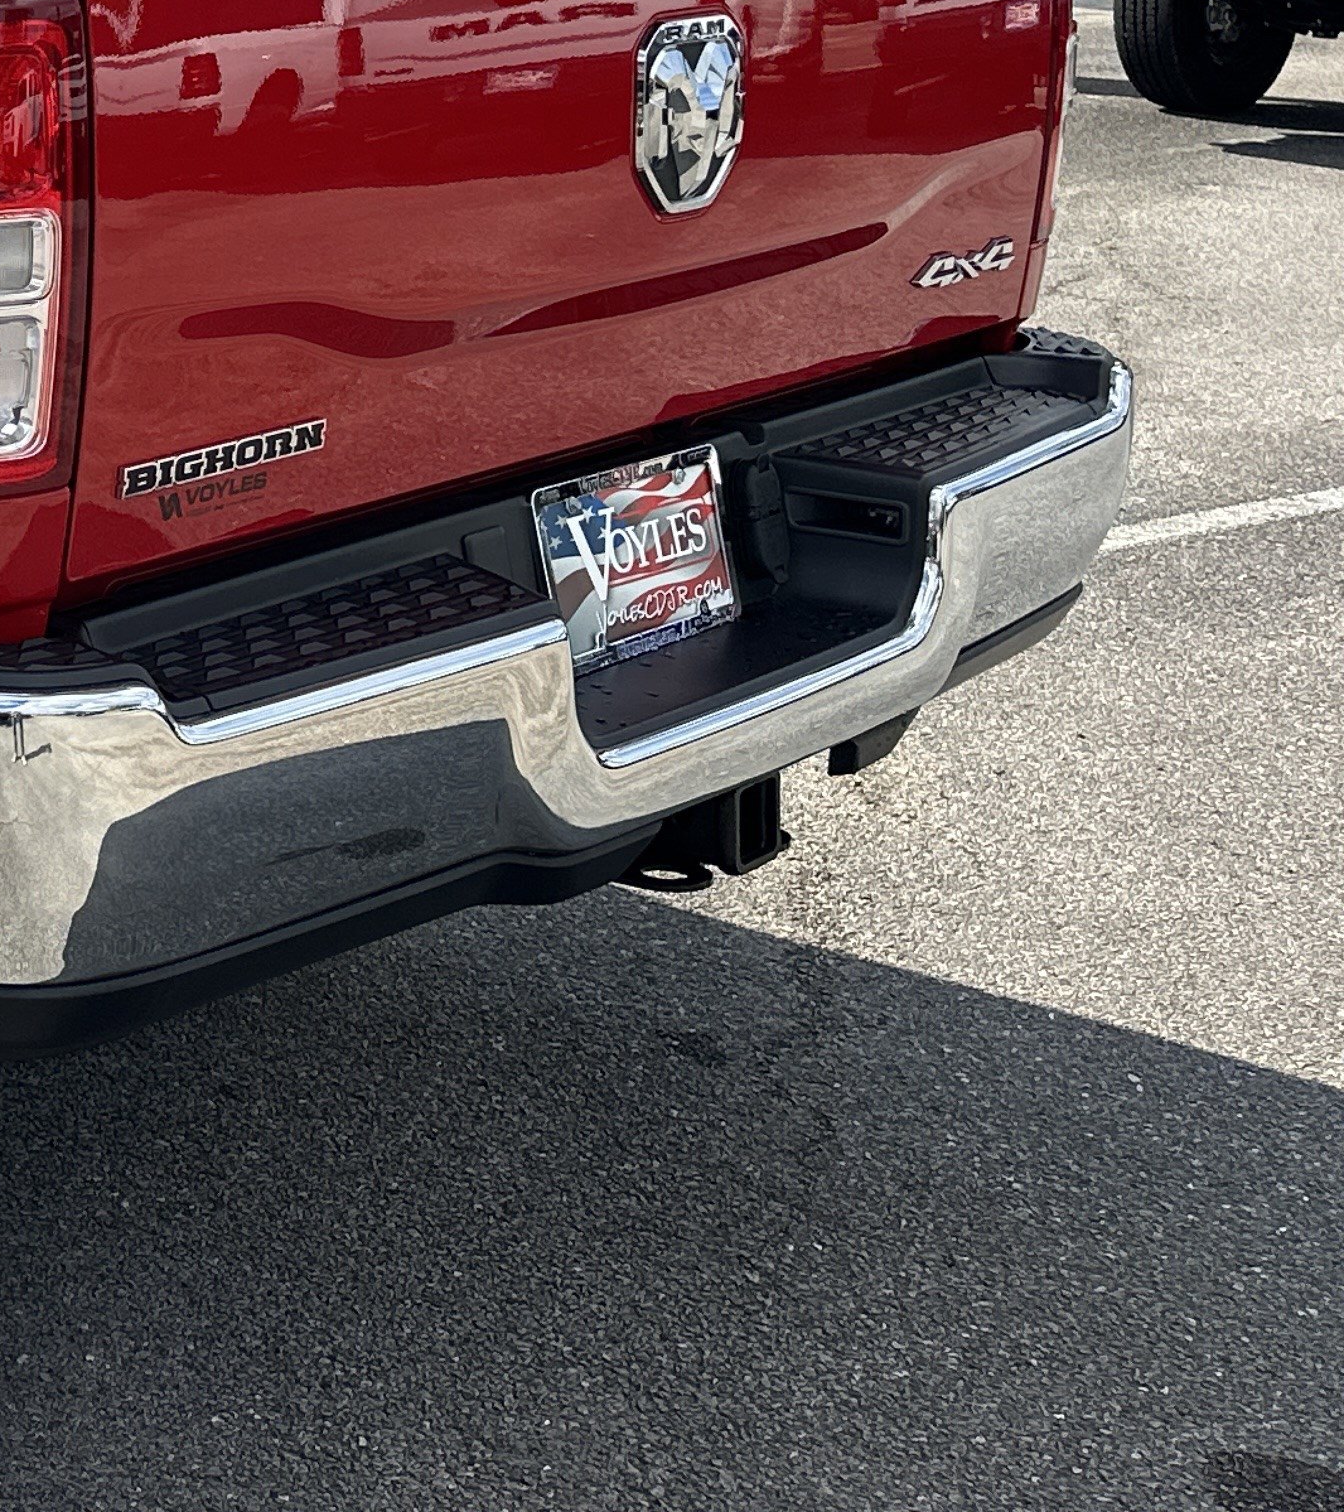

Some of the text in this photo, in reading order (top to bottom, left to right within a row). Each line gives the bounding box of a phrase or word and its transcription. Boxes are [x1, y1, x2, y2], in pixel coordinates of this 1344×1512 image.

[665, 18, 726, 41] RAM
[116, 418, 328, 499] BIGHORN
[185, 471, 268, 506] VOYLES
[566, 506, 707, 602] VOYLES
